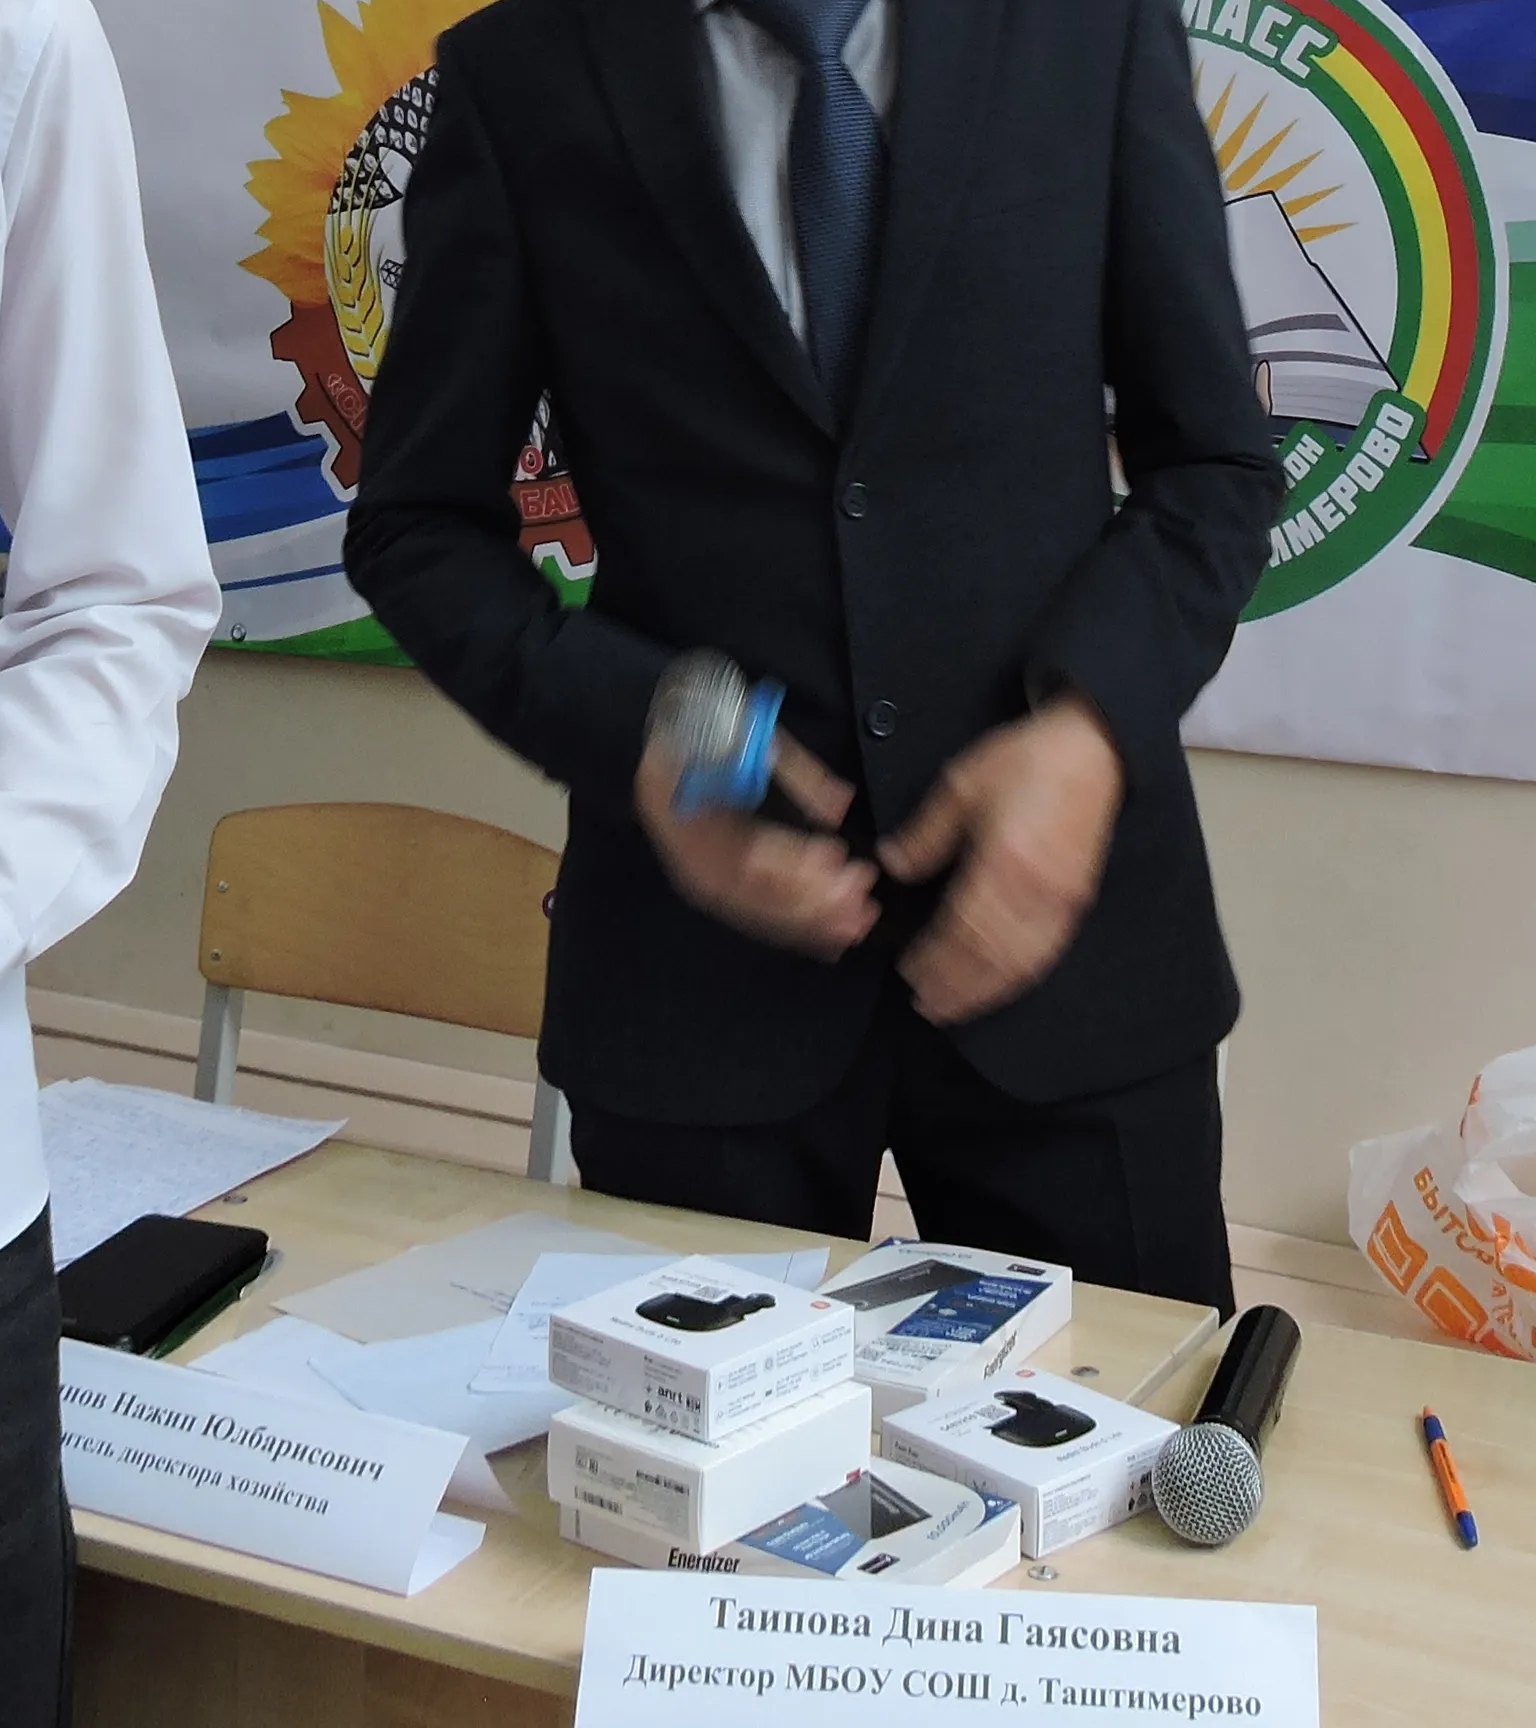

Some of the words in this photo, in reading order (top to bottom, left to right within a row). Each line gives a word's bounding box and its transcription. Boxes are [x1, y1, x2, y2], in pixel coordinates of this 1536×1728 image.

[1268, 402, 1414, 568] ИМЕРОВО
[112, 1391, 197, 1433] Нажип
[200, 1413, 385, 1482] Юлбарисович
[116, 1445, 223, 1489] директора
[225, 1473, 330, 1516] хозяйства
[667, 1546, 741, 1574] Energizer
[710, 1596, 871, 1638] Таипова
[882, 1606, 983, 1648] Дина
[997, 1613, 1182, 1655] Гаясовна
[623, 1654, 775, 1691] Директор
[785, 1664, 893, 1696] МБОУ
[902, 1669, 991, 1701] СОШ
[1000, 1679, 1027, 1707] д.
[1039, 1677, 1262, 1720] Таштимерово
